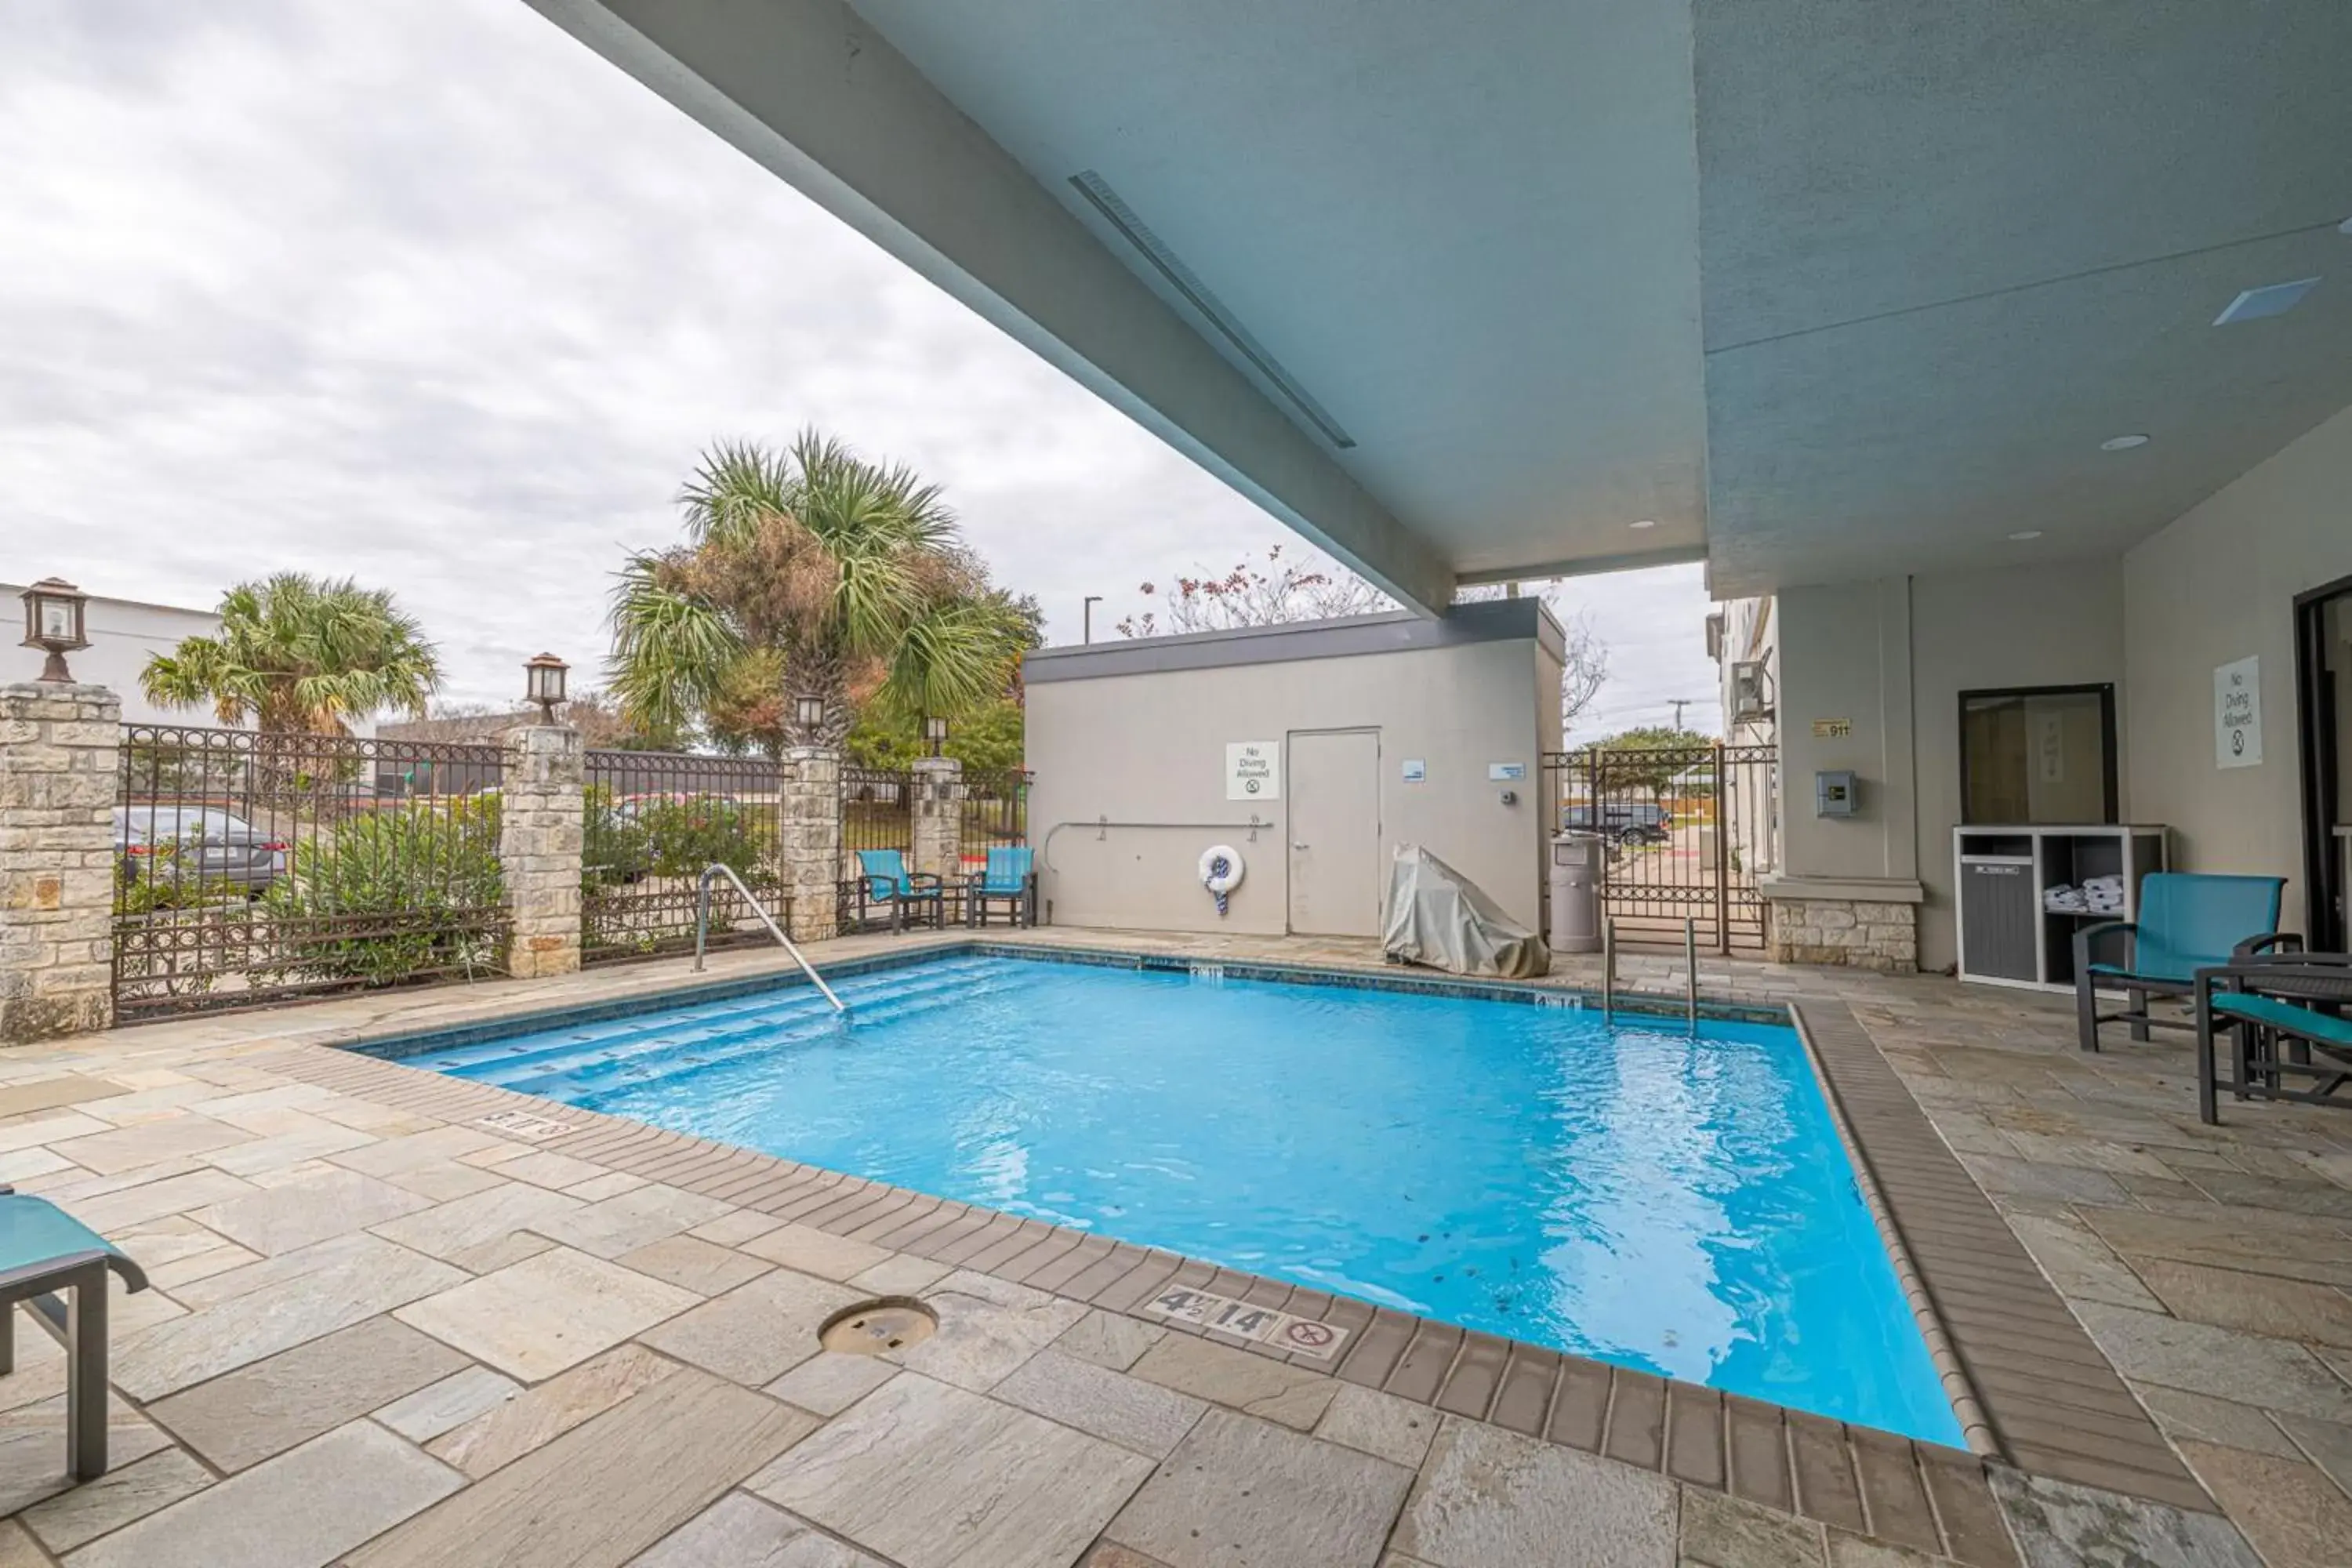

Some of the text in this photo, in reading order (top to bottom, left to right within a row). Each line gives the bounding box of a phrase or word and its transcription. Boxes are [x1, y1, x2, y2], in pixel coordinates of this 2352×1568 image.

[2230, 672, 2242, 686] No
[2226, 691, 2249, 709] Diving
[2223, 711, 2252, 728] Allowed
[1246, 746, 1260, 757] No
[1240, 757, 1266, 770] Diving
[1236, 768, 1269, 779] Allowed
